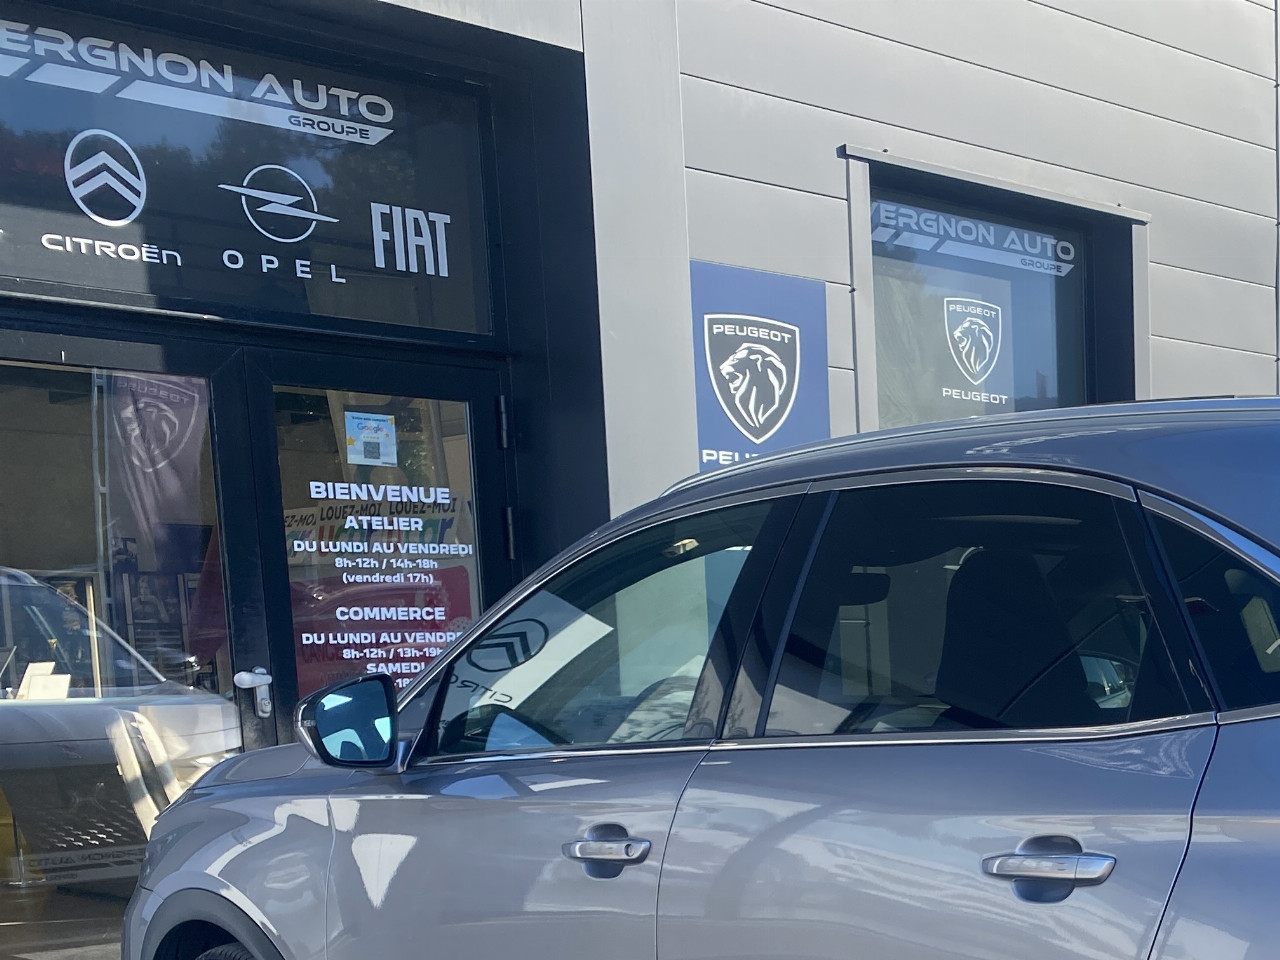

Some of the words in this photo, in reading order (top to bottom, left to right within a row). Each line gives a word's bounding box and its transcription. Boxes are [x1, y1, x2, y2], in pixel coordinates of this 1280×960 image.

[251, 73, 394, 124] AUTO
[287, 114, 370, 140] GROUPE
[370, 202, 451, 278] FIAT
[1003, 230, 1075, 261] AUTO
[222, 250, 347, 284] OPEL
[1020, 258, 1063, 273] GROUPE
[949, 304, 997, 319] PEUGEOT
[712, 324, 792, 344] PEUGEOT
[942, 387, 1008, 405] PEUGEOT
[309, 481, 451, 504] BIENVENUE
[344, 516, 423, 531] ATELIER
[293, 540, 317, 552] DU
[320, 541, 369, 553] LUNDI
[372, 542, 394, 553] AU
[397, 543, 473, 555] VENDREDI
[334, 557, 379, 569] 8h-12h
[389, 558, 438, 570] 14h-18h
[342, 572, 404, 584] (vendredi
[407, 572, 434, 584] 17h)
[335, 606, 446, 621] COMMERCE
[302, 633, 325, 645] DU
[328, 632, 376, 645] LUNDI
[379, 632, 401, 643] AU
[342, 648, 386, 659] 8h-12h
